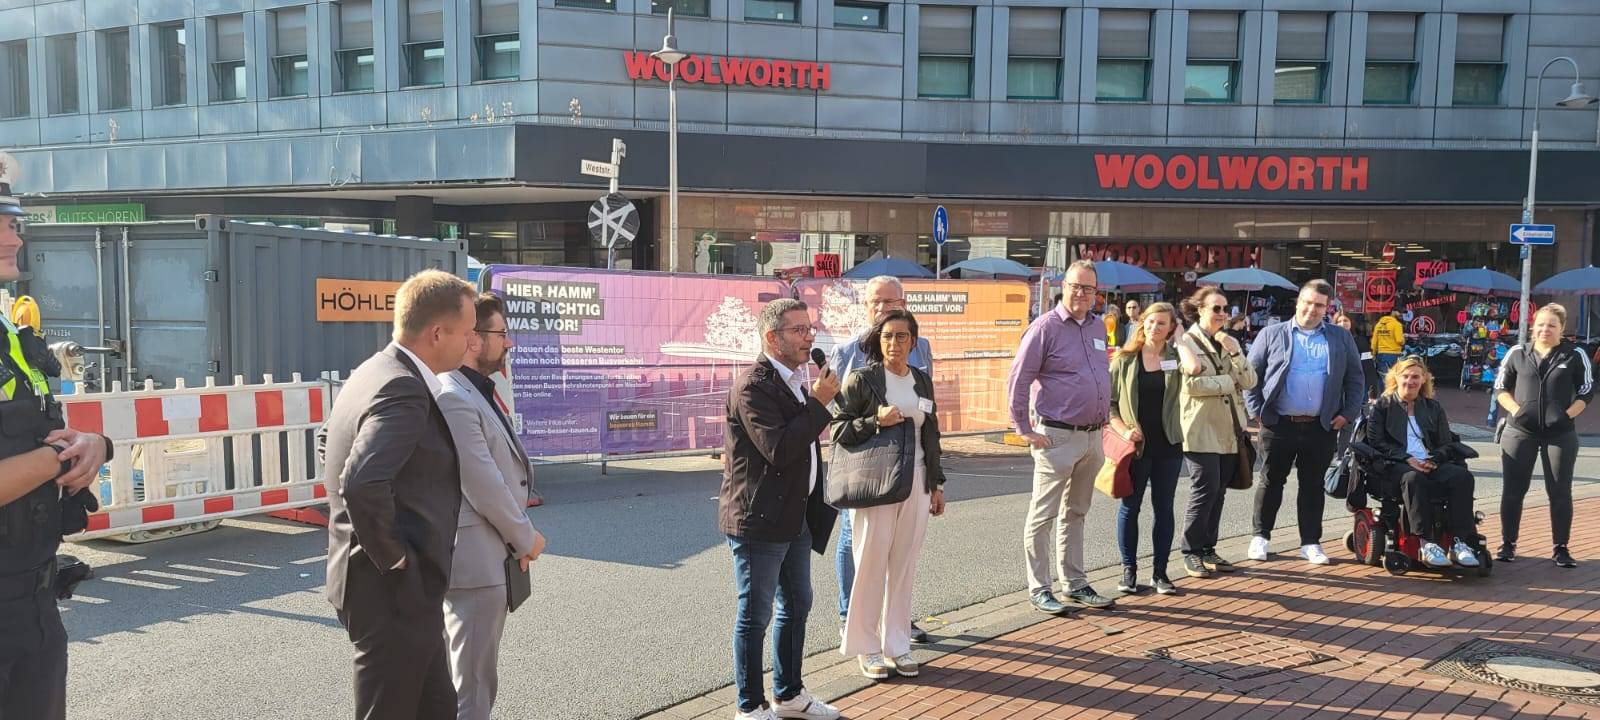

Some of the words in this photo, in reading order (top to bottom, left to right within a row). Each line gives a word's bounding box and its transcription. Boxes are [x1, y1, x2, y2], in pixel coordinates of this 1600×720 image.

[623, 50, 831, 90] WOOLWORTH
[585, 162, 612, 174] Weststr.
[1094, 154, 1369, 191] WOOLWORTH
[58, 212, 95, 223] GUTES
[97, 209, 138, 222] HÖREN
[816, 260, 834, 272] SALE
[506, 283, 543, 298] HIER
[547, 284, 596, 299] HAMM'
[1370, 284, 1392, 296] SALE
[906, 294, 923, 303] DAS
[924, 294, 951, 303] HAMM'
[952, 294, 967, 303] WIR
[506, 300, 536, 314] WIR
[541, 302, 601, 316] RICHTIG
[906, 304, 943, 313] KONKRET
[945, 304, 963, 313] VOR:
[506, 317, 540, 331] WAS
[544, 318, 579, 332] VOR!
[519, 344, 543, 353] bauen
[544, 344, 559, 353] das
[561, 345, 584, 354] beste
[585, 346, 624, 354] Westentor
[516, 357, 539, 365] einen
[540, 356, 560, 365] noch
[561, 357, 598, 366] besseren
